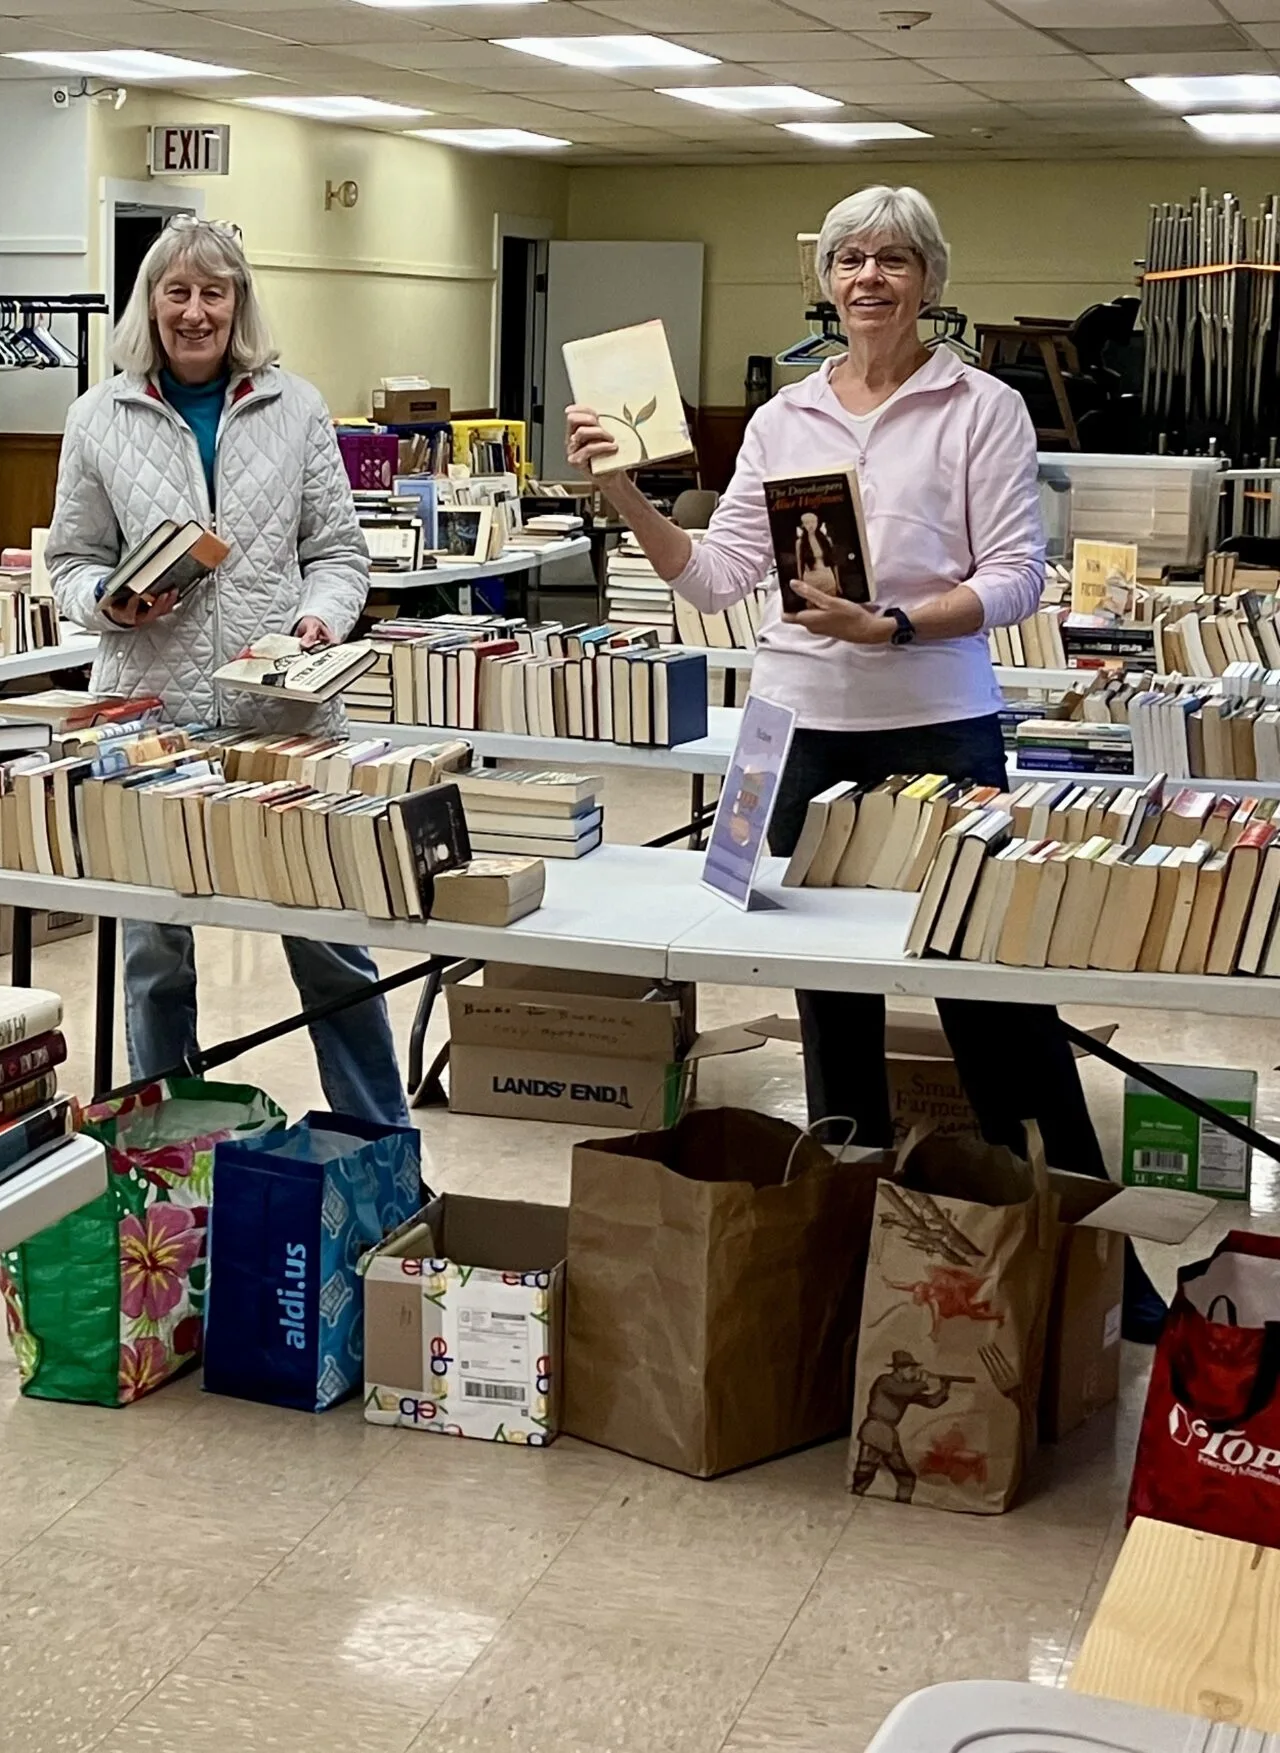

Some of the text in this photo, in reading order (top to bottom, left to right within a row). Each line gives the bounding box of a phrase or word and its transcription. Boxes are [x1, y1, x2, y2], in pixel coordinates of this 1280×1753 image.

[165, 129, 214, 169] EXIT
[767, 488, 787, 500] The
[570, 1084, 617, 1103] END
[911, 1072, 964, 1099] Smal
[896, 1089, 969, 1117] Farmer
[278, 1242, 307, 1350] aldi.us
[1191, 1418, 1280, 1471] TOP
